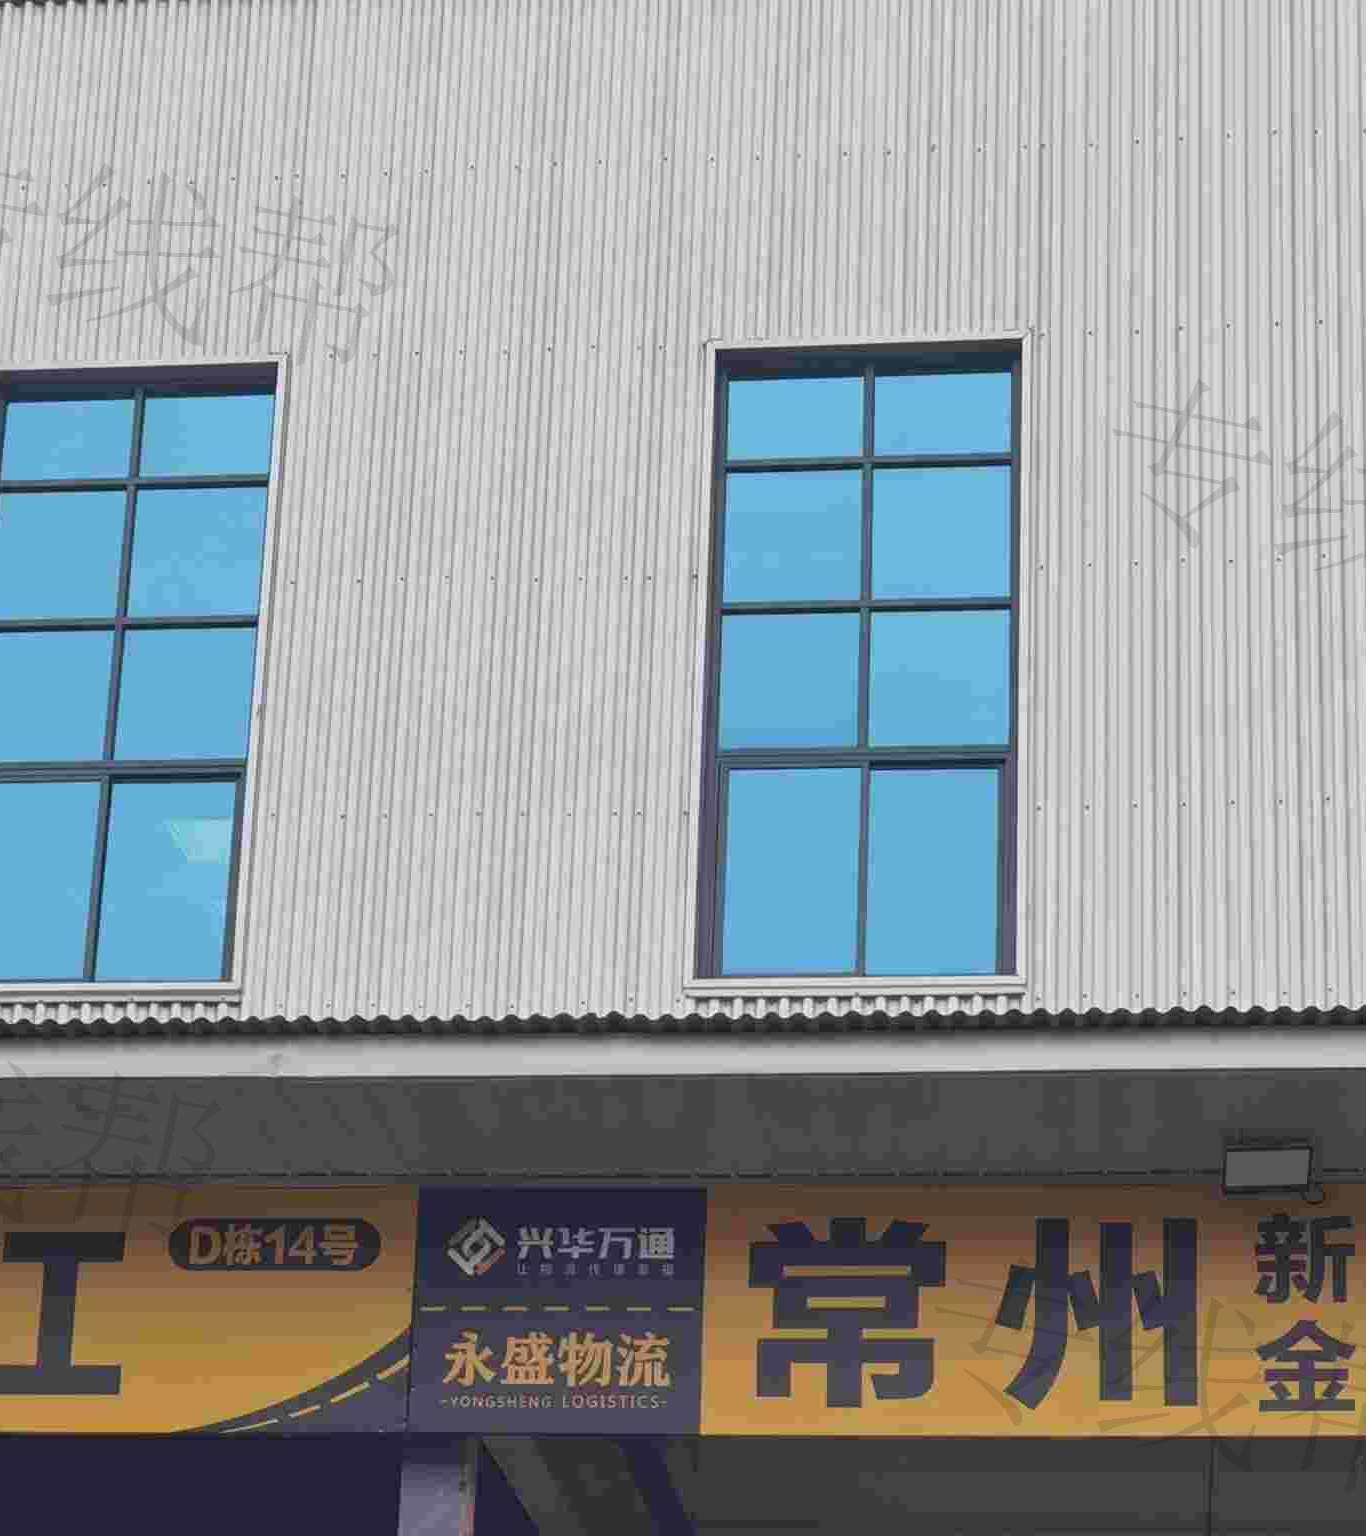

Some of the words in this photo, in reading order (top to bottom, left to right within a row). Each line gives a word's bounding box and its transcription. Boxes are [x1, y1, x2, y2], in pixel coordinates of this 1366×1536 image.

[188, 1222, 360, 1268] D栋14号
[517, 1226, 676, 1260] 兴华万通
[748, 1216, 1199, 1410] 常州
[443, 1331, 671, 1387] 永盛物流
[450, 1394, 555, 1408] YONGSHENG
[562, 1394, 661, 1409] LOGISTICS
